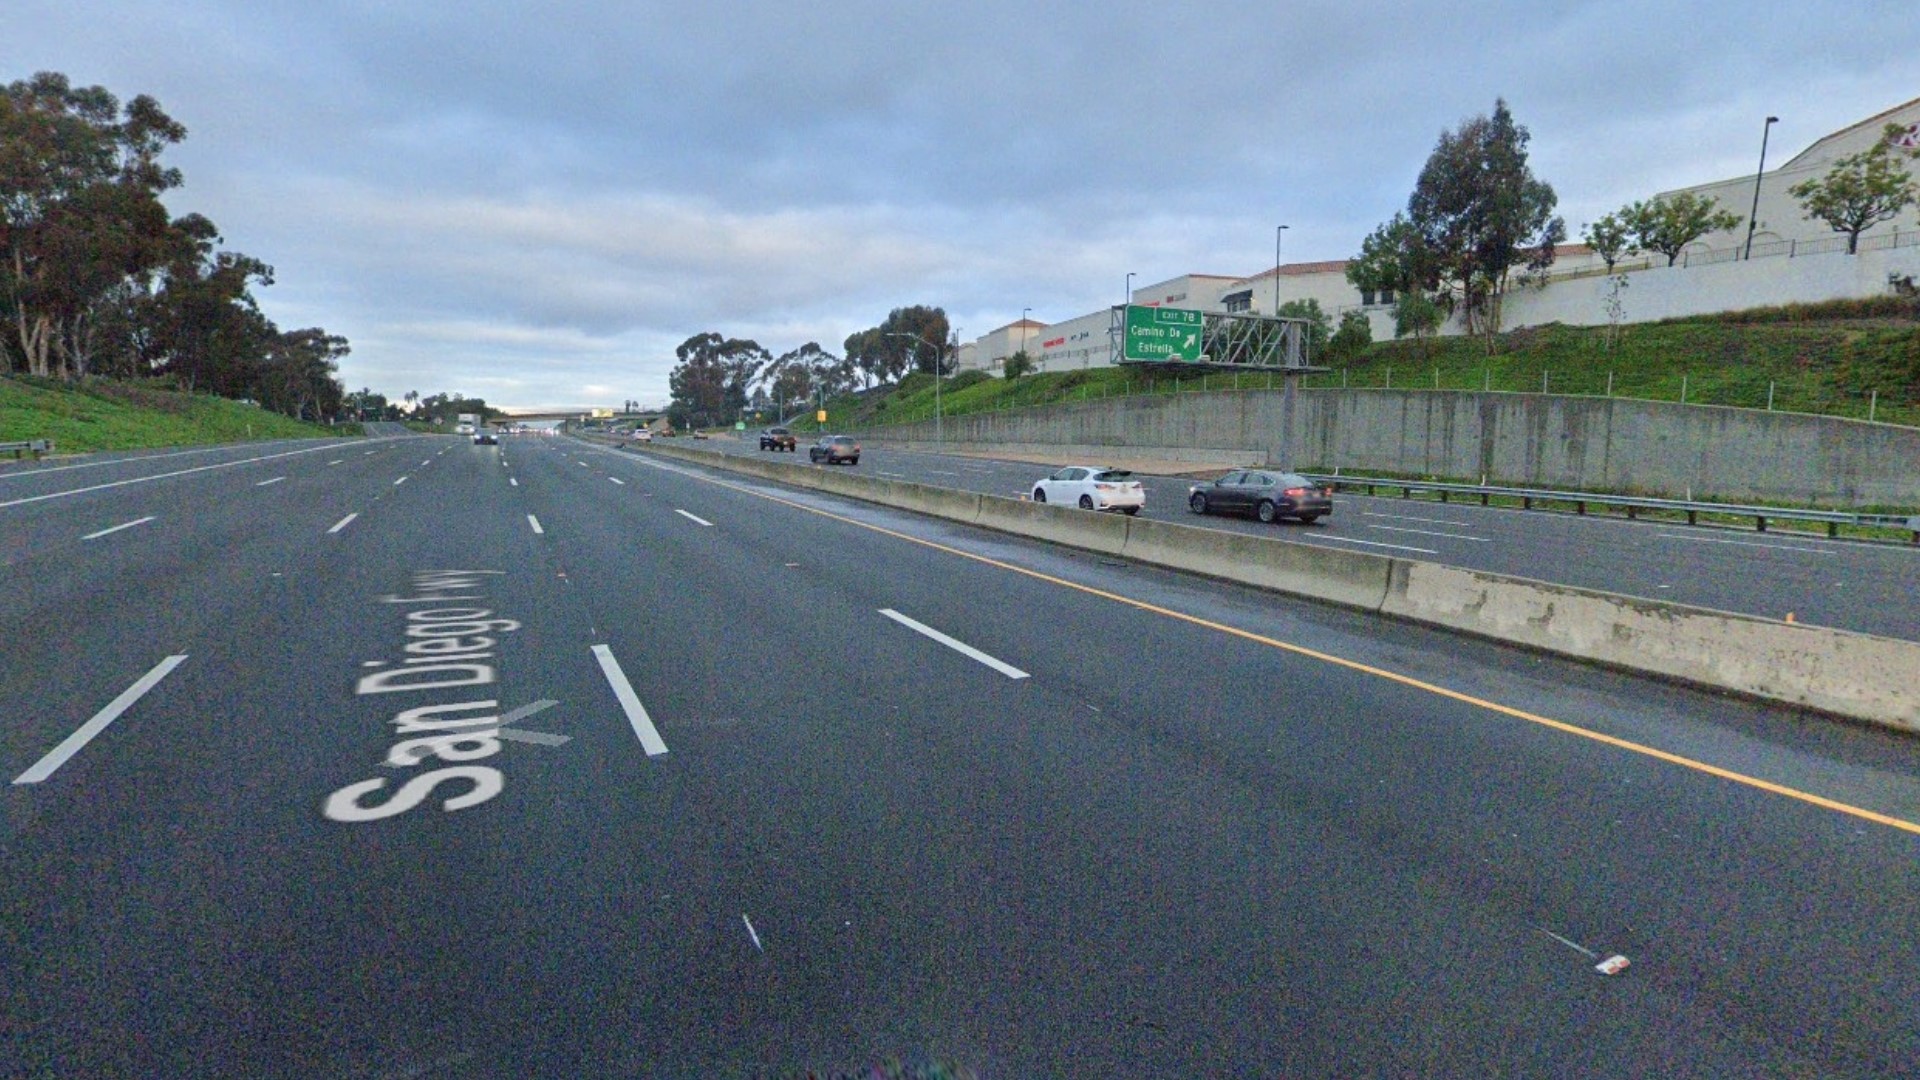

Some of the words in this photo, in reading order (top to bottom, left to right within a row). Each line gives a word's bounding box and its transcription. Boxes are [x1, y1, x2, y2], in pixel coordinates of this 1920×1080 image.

[1182, 312, 1195, 322] 78
[1131, 325, 1165, 337] Camino
[1169, 327, 1181, 338] De
[1138, 342, 1174, 354] Estrella
